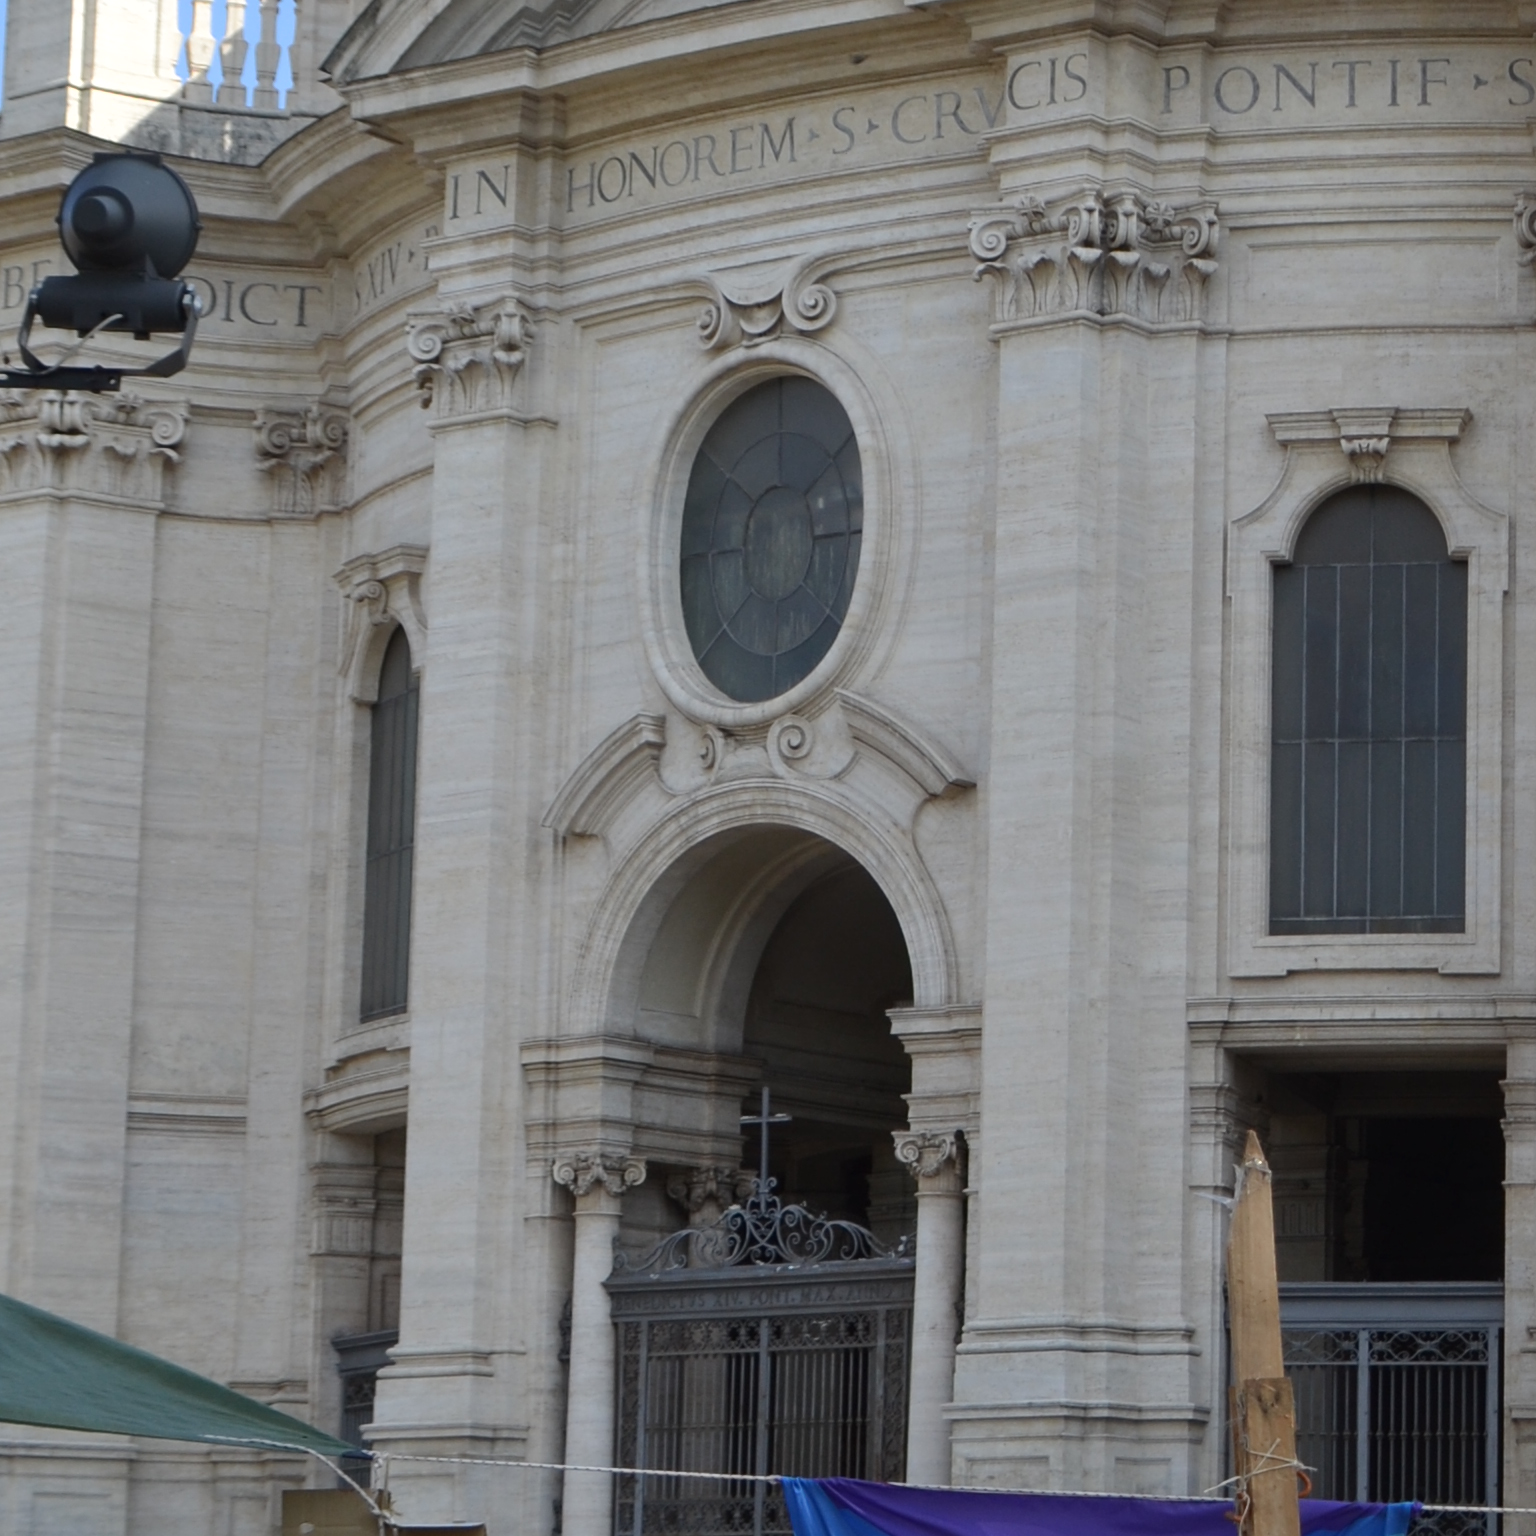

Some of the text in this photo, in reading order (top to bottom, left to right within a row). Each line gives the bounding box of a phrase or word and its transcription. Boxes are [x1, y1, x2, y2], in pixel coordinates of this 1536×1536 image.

[449, 164, 510, 221] IN
[566, 115, 797, 214] HONOREM
[832, 106, 856, 155] S
[890, 52, 1089, 146] CRVCIS
[1160, 57, 1451, 116] PONTIF
